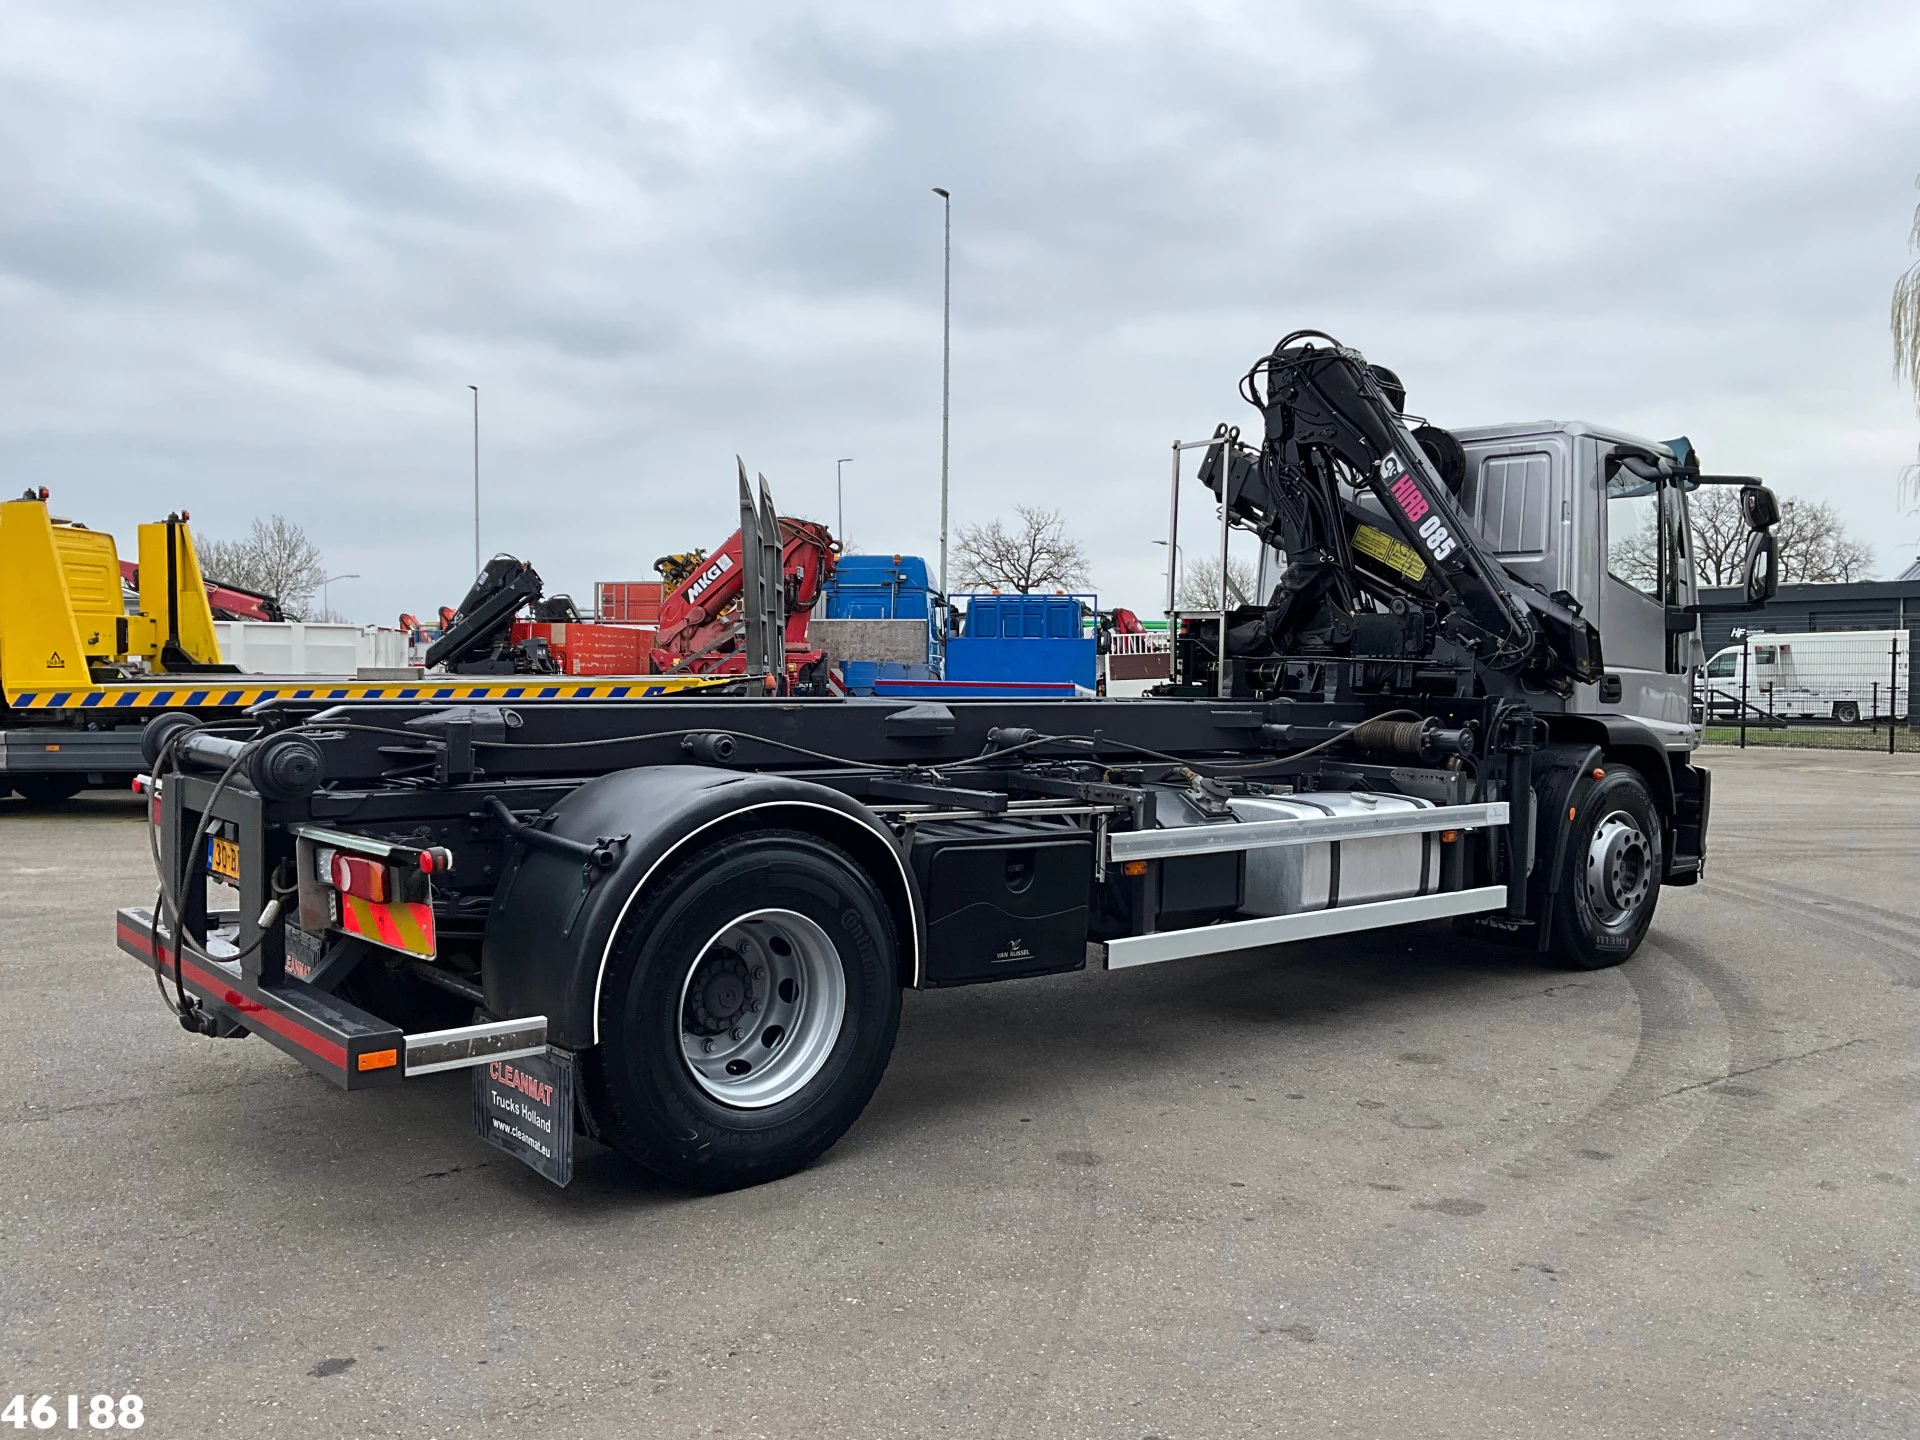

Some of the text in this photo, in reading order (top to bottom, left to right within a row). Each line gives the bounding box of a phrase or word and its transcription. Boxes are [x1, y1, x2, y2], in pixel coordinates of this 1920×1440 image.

[1391, 473, 1429, 522] HIAB
[1419, 515, 1457, 561] 085
[687, 564, 722, 605] MKG
[1730, 627, 1746, 638] HF
[216, 842, 240, 872] 30-B
[1594, 935, 1630, 952] PIRELLI
[489, 1060, 554, 1107] CLEANMAT
[491, 1089, 551, 1134] Trucks Holland
[492, 1117, 551, 1159] www.cleanmat.eu
